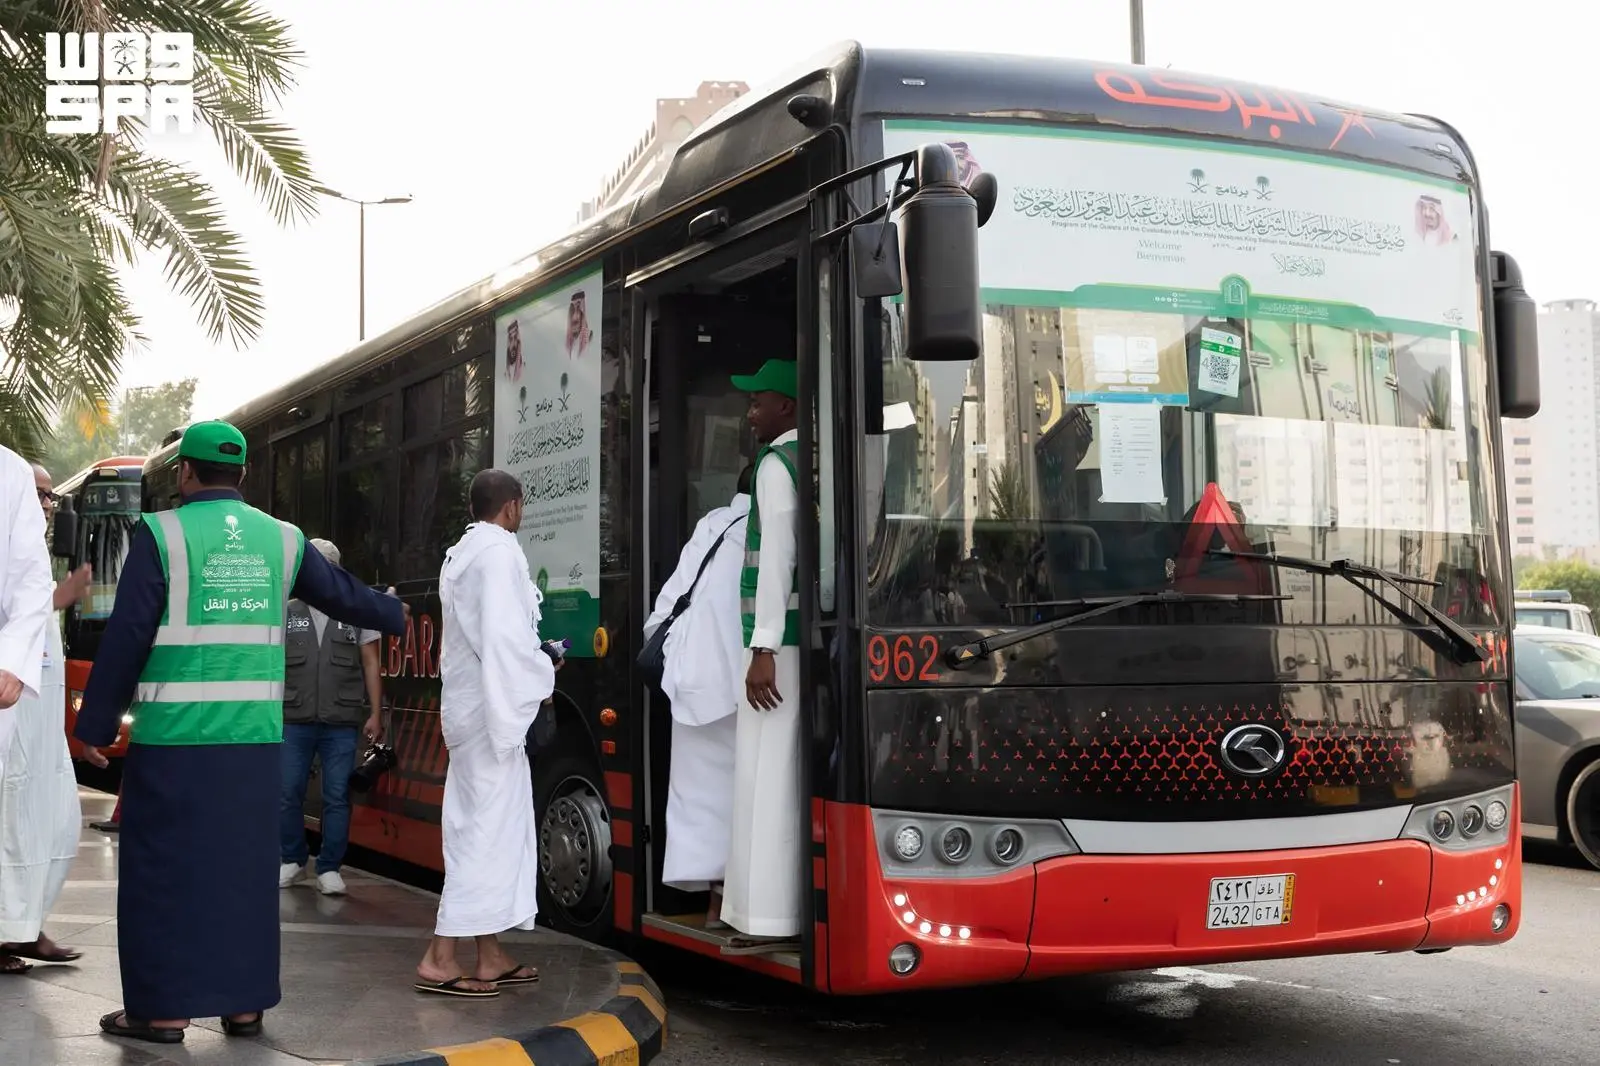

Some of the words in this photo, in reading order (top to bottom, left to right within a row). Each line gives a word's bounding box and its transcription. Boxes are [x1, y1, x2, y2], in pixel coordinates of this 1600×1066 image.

[1215, 185, 1249, 198] برنامج
[1051, 220, 1079, 228] Program
[1100, 223, 1121, 231] Guests
[1141, 226, 1171, 235] Custodian
[1218, 233, 1243, 241] Mosques
[1137, 239, 1183, 251] Welcome
[203, 598, 229, 612] النقل
[231, 602, 238, 612] و
[240, 598, 269, 612] الحركة
[868, 634, 939, 682] 962
[1216, 880, 1252, 901] ٢٤٣٢
[1212, 905, 1250, 926] 2432
[1255, 906, 1280, 920] GTA
